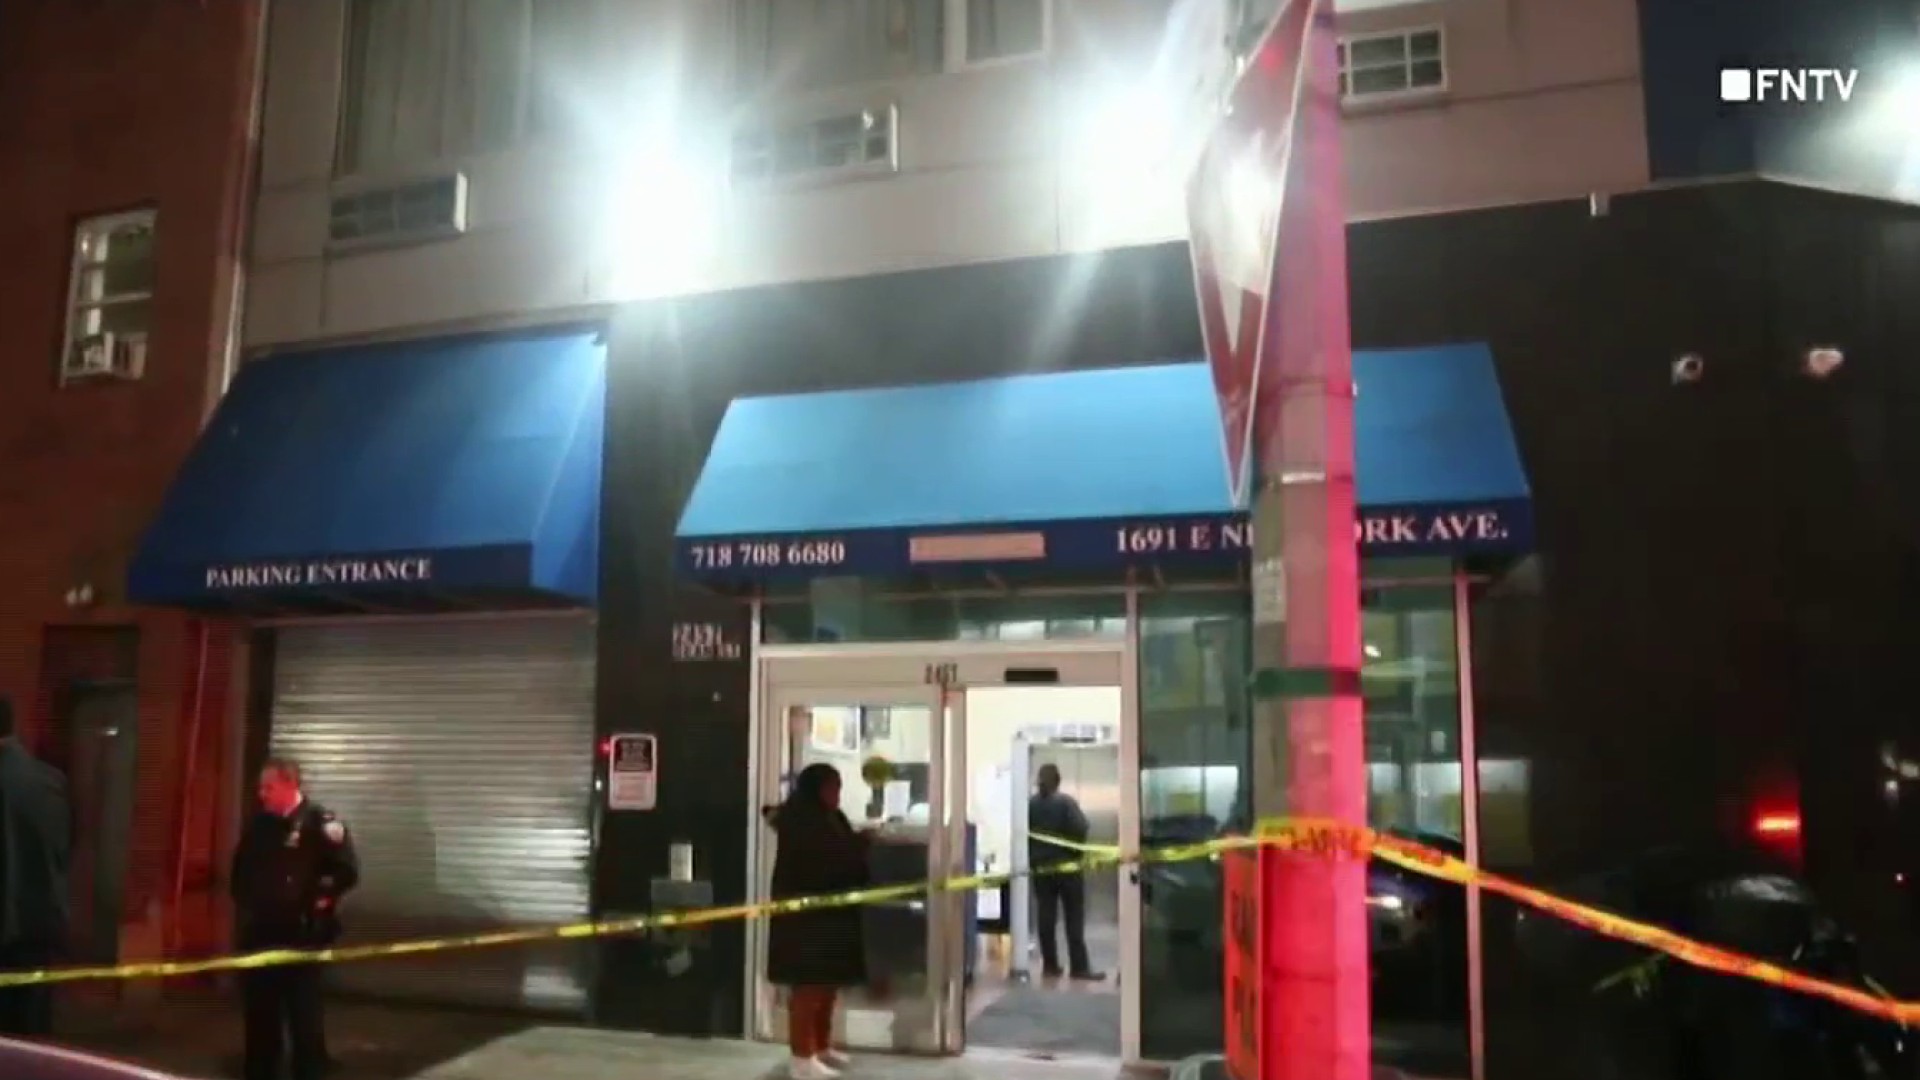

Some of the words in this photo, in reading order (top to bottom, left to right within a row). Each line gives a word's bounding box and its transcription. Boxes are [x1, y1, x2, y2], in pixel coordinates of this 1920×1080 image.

[1117, 526, 1177, 552] 1691
[1190, 523, 1211, 549] E
[1426, 512, 1508, 541] AVE.
[691, 544, 733, 569] 718
[738, 541, 781, 566] 708
[787, 540, 846, 565] 6680
[206, 563, 302, 588] PARKING
[306, 558, 432, 585] ENTRANCE
